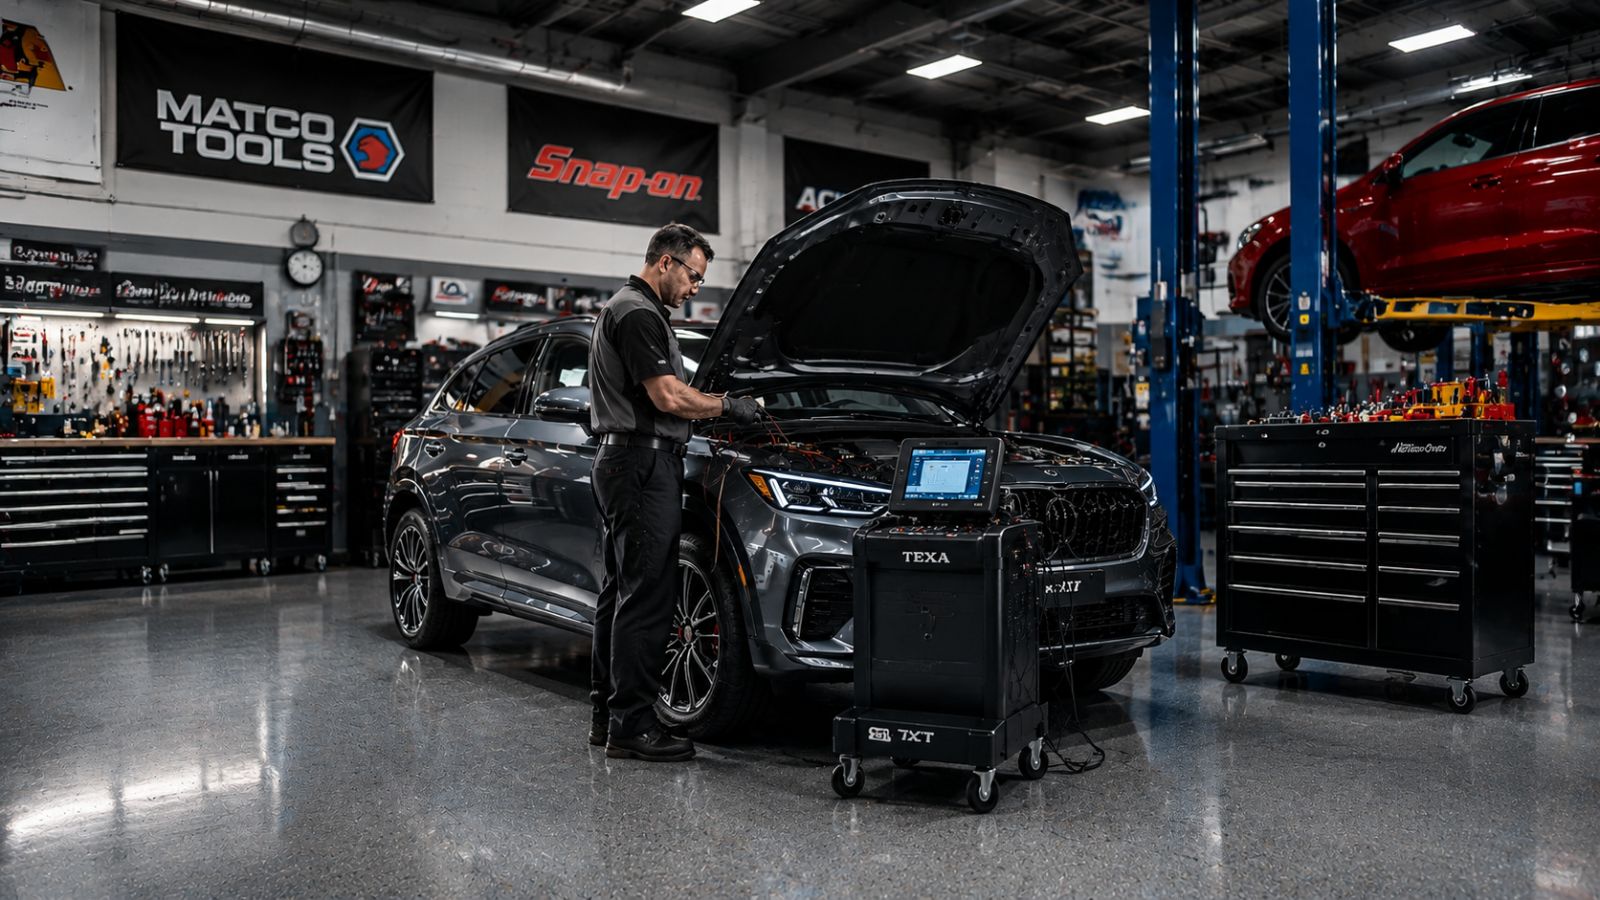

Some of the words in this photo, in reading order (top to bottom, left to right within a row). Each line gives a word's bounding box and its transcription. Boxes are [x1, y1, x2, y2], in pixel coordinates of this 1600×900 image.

[157, 89, 335, 143] MATCO
[160, 120, 335, 173] TOOLS
[527, 143, 703, 201] Snap-on
[902, 551, 950, 564] TEXA
